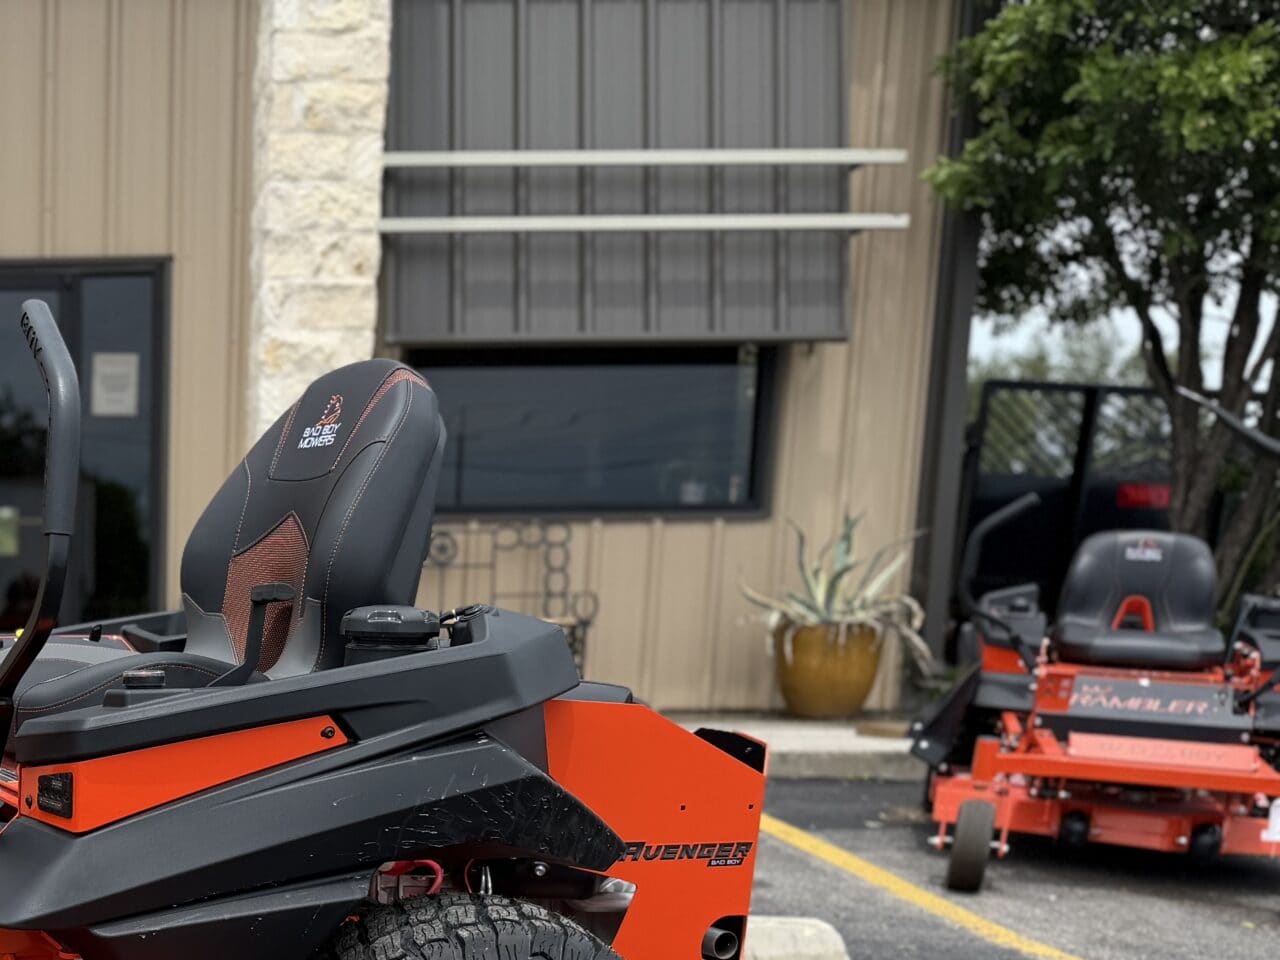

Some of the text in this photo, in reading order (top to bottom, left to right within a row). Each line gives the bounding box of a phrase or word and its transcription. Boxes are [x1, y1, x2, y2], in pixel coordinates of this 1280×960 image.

[303, 423, 341, 438] BAD BOY
[297, 434, 337, 449] MOWERS
[618, 841, 754, 862] AVENGER
[710, 858, 742, 867] BAD BOY
